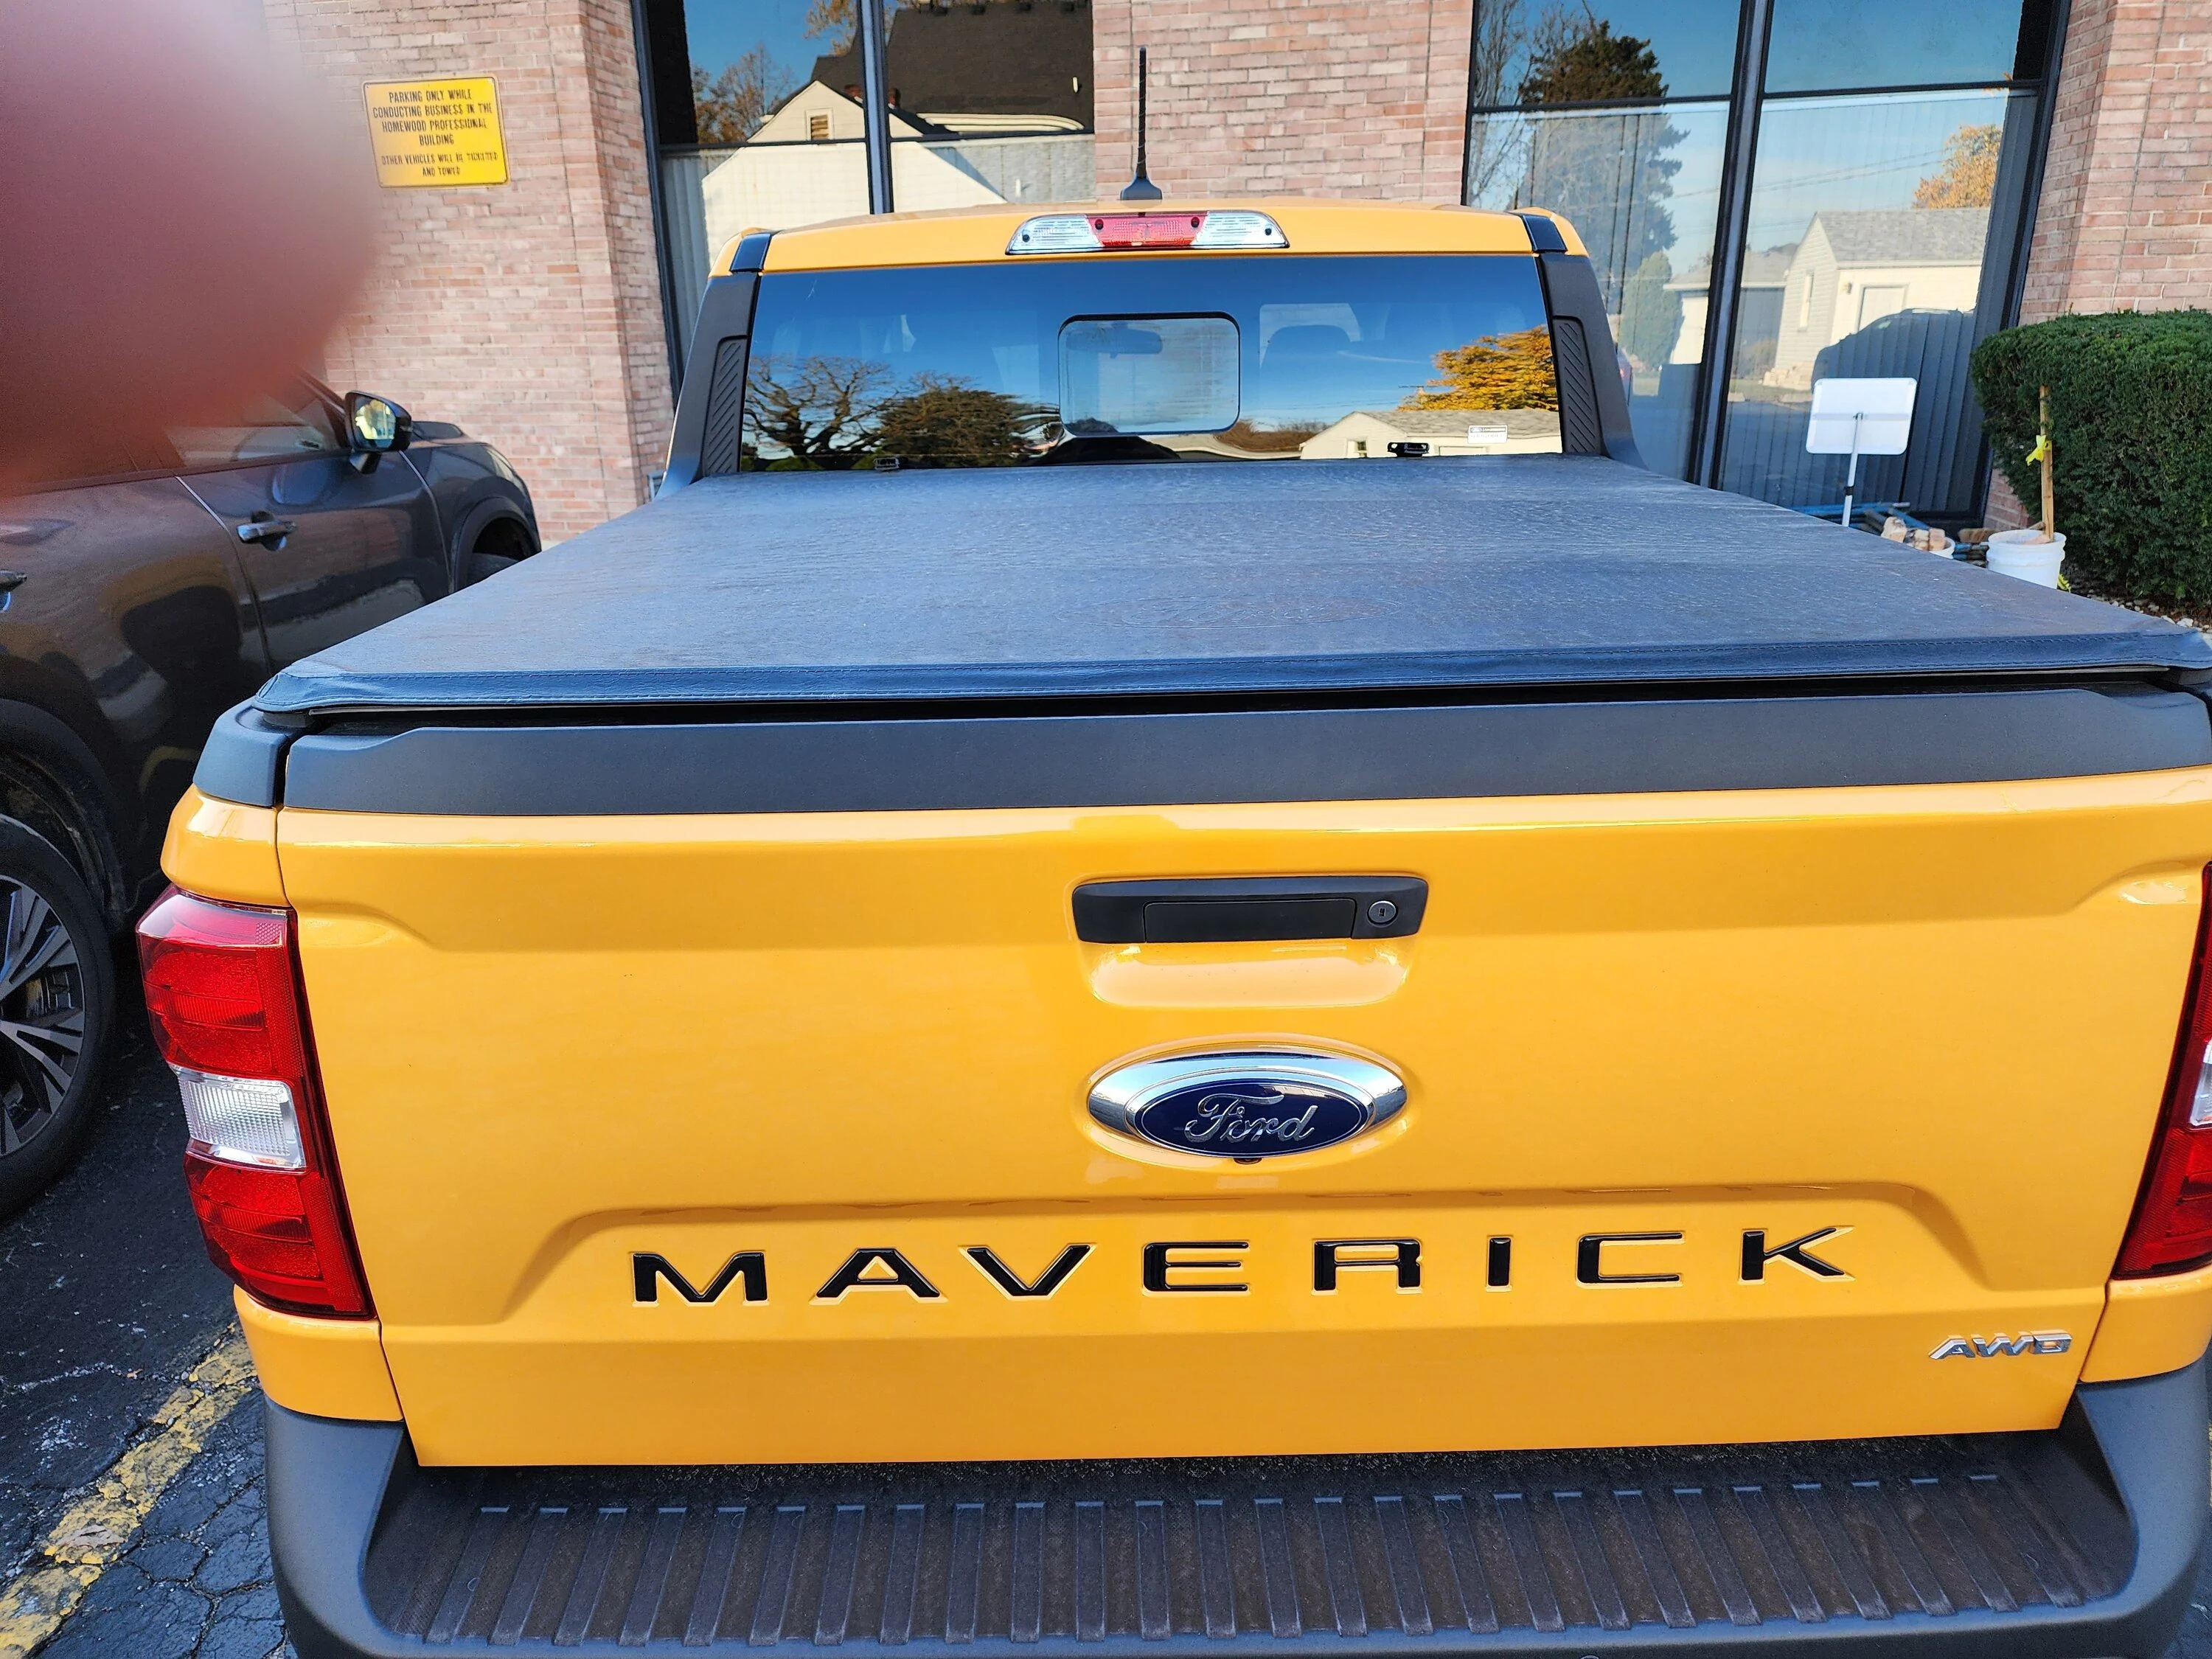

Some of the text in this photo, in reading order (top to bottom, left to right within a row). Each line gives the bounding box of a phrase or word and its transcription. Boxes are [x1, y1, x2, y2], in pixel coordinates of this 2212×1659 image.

[389, 88, 473, 103] PARKING ONLY WHILE
[372, 102, 493, 118] CONDUCTING BUSINESS IN THE
[381, 118, 487, 133] HOMEWOOD PROFESSIONAL
[419, 134, 455, 146] BUILDING
[381, 153, 403, 165] OTHER
[405, 153, 435, 164] VEHICLES
[422, 167, 435, 177] AND
[1183, 1093, 1318, 1144] Ford
[632, 1227, 1851, 1306] MAVERICK
[1928, 1330, 2073, 1360] AWD
